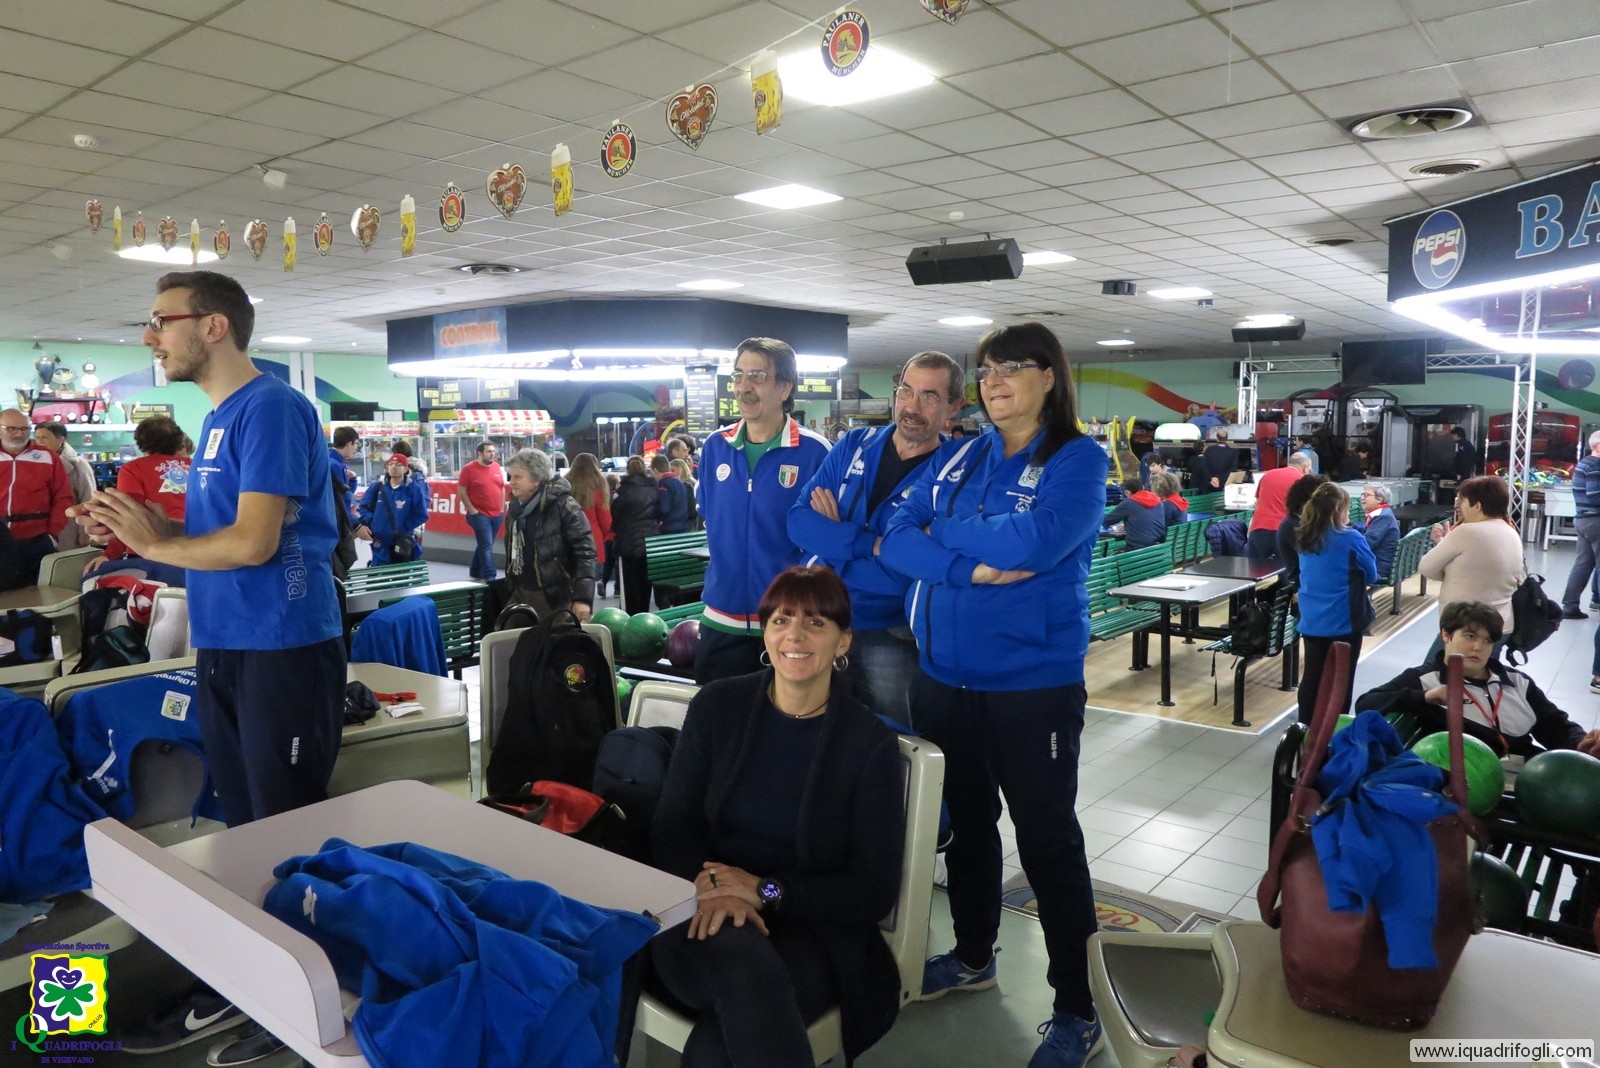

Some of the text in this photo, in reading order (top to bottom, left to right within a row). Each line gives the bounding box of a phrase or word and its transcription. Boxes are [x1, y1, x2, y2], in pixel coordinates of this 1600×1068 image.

[823, 11, 866, 48] PAULANER
[830, 49, 866, 76] MÜNCHEN
[601, 123, 634, 151] PAULANER
[1415, 228, 1461, 255] PEPSI
[428, 493, 456, 514] cial
